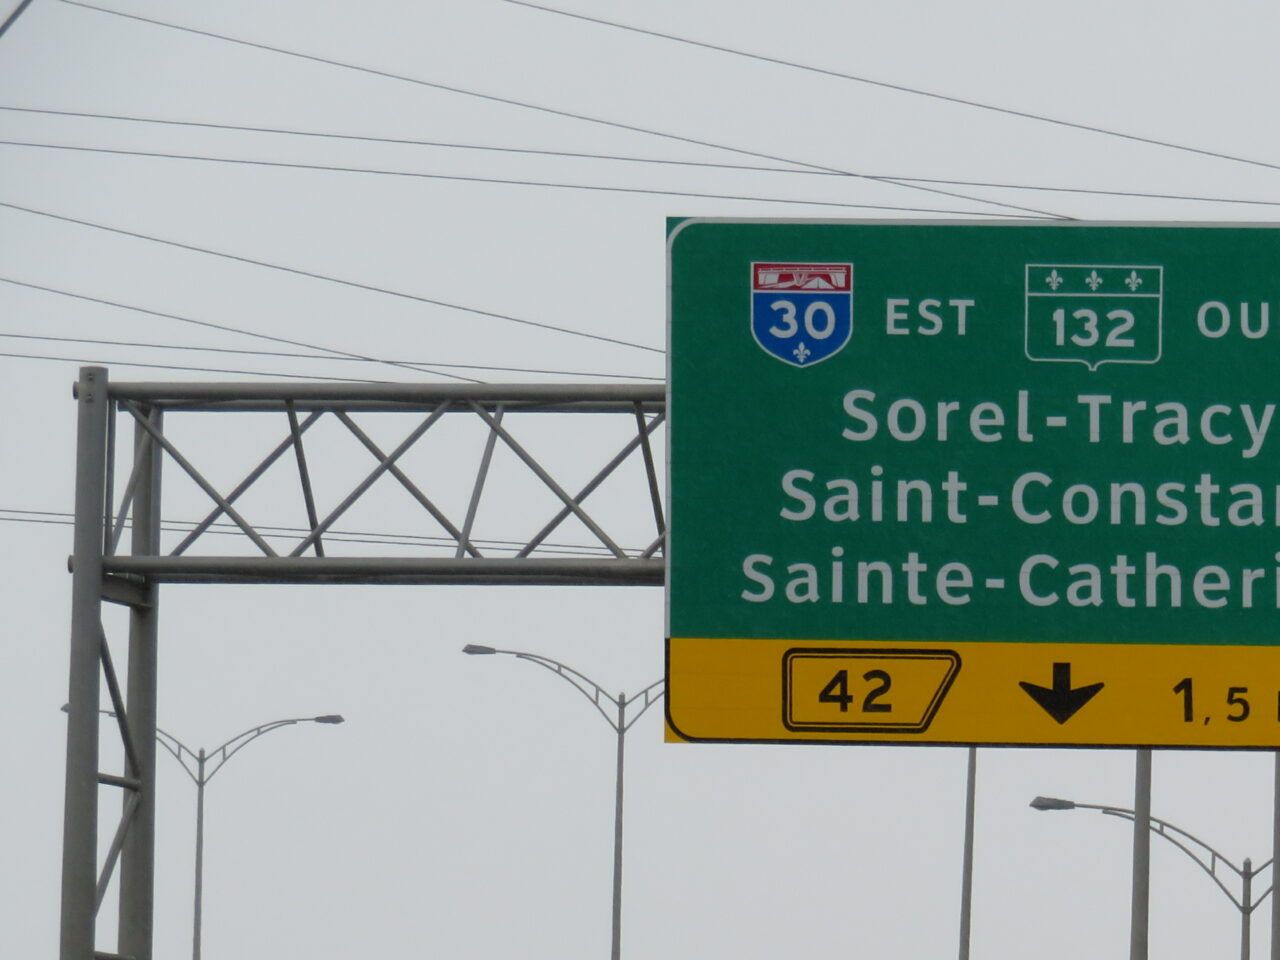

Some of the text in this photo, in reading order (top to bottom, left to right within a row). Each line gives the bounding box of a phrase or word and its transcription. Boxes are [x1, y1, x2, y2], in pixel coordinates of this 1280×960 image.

[769, 300, 836, 340] 30
[886, 298, 975, 335] EST
[1053, 309, 1136, 348] 132
[842, 389, 1276, 458] Sorel-Tracy
[818, 669, 893, 713] 42
[1172, 677, 1251, 726] 1,5
